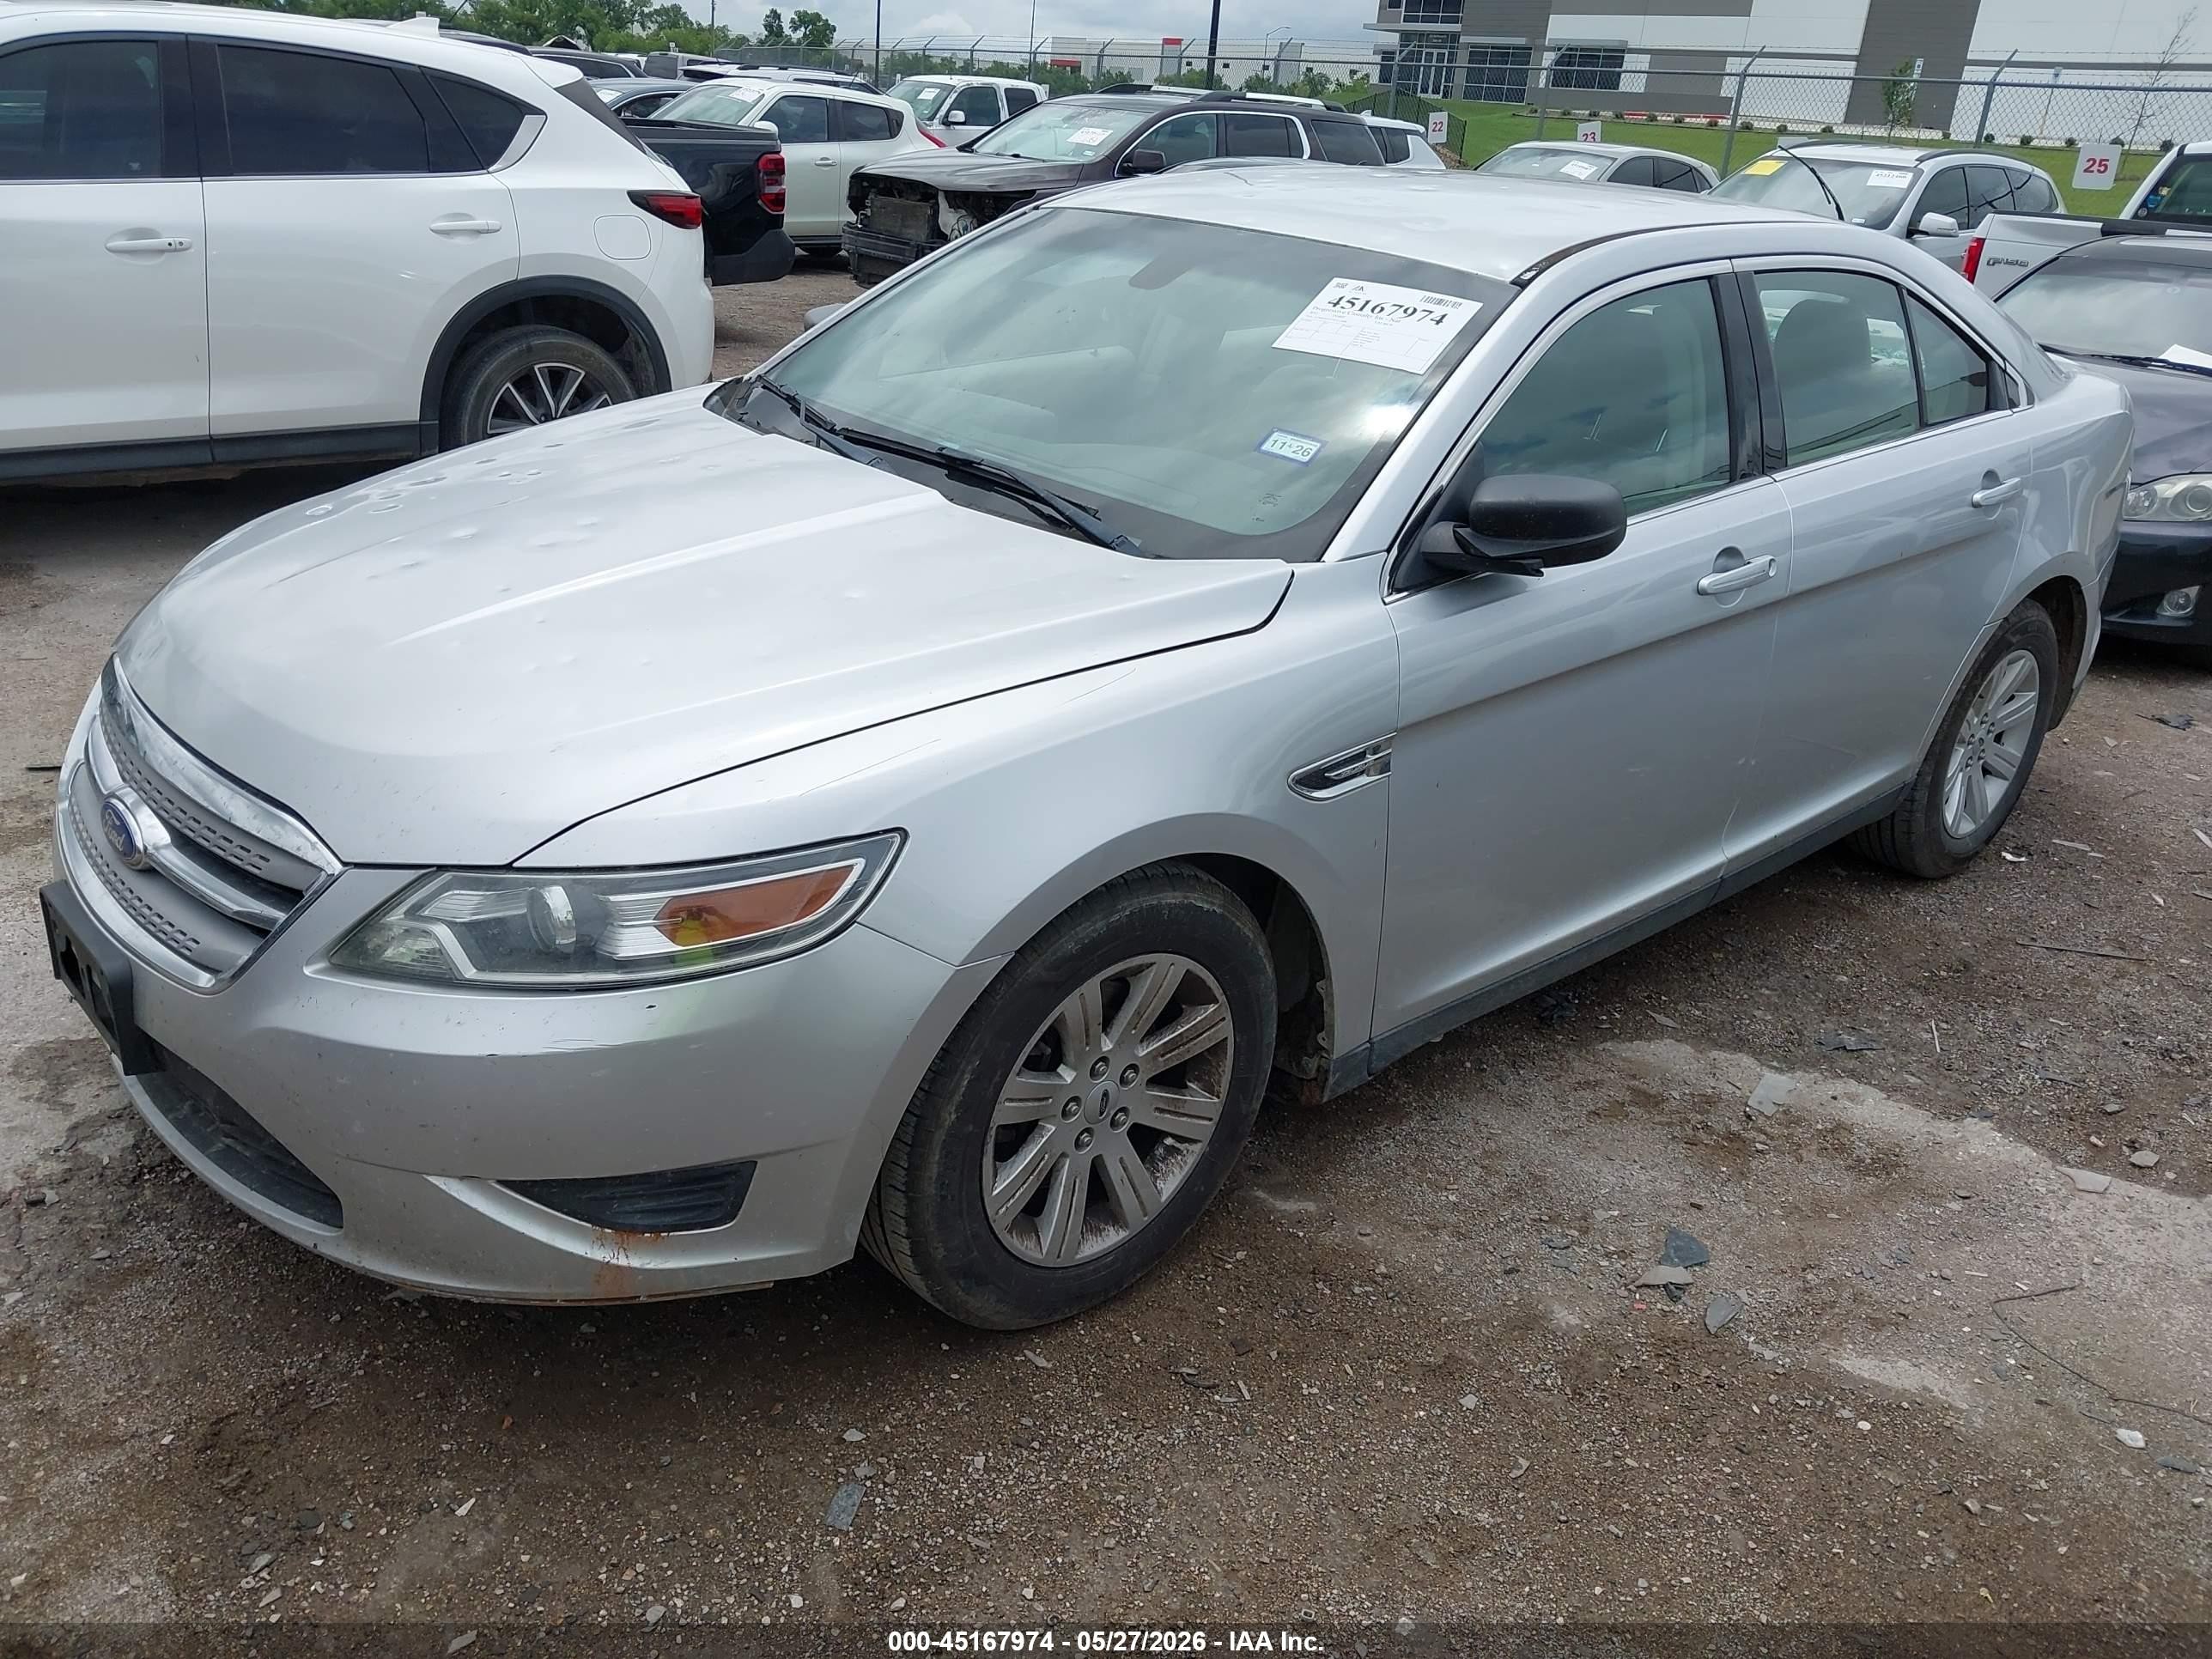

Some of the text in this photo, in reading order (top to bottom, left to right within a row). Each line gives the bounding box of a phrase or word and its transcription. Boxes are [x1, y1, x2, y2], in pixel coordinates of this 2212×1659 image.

[1431, 121, 1443, 132] 22
[1581, 131, 1596, 142] 23
[2082, 157, 2109, 173] 25
[1328, 295, 1449, 325] 45167974
[104, 809, 125, 852] Ford
